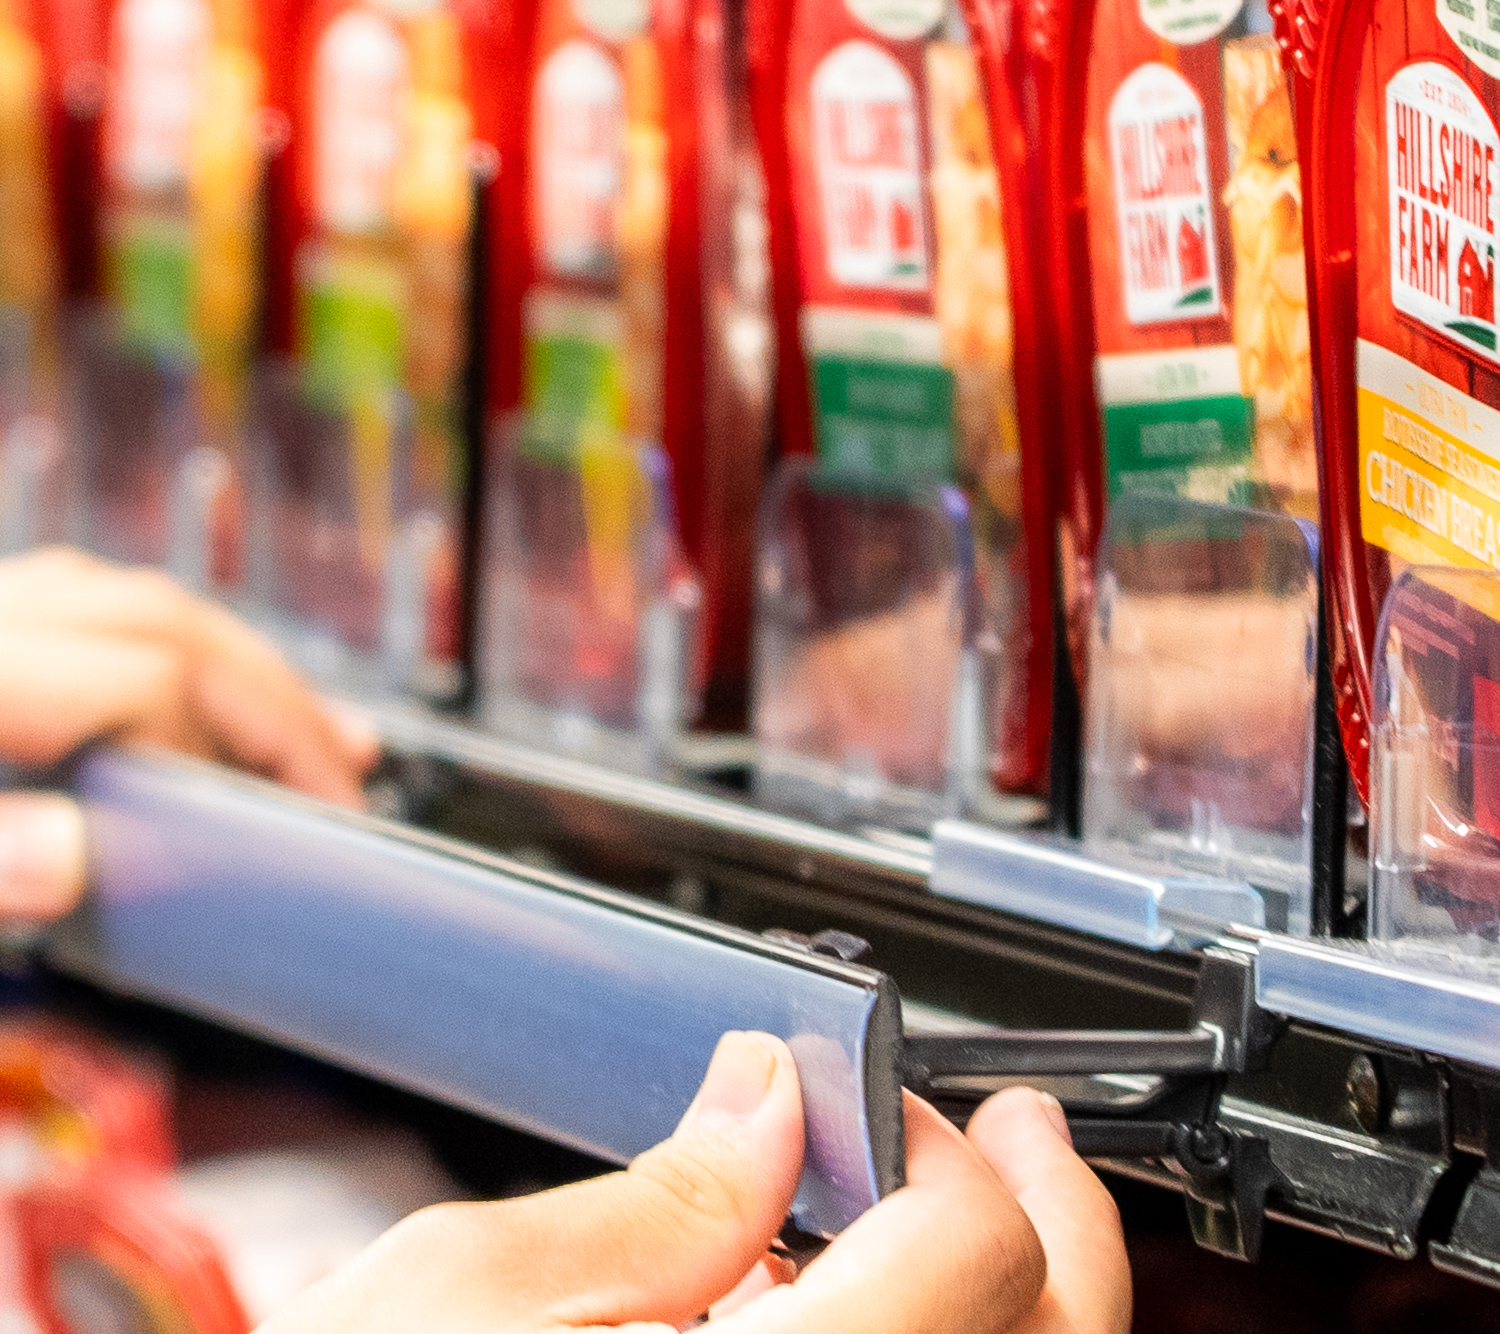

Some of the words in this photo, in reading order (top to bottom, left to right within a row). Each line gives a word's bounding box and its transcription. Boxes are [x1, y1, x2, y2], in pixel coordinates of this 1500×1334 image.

[1396, 99, 1494, 235] HILLSHIRE
[1399, 195, 1449, 306] FARM
[1366, 449, 1449, 539] CHICKEN
